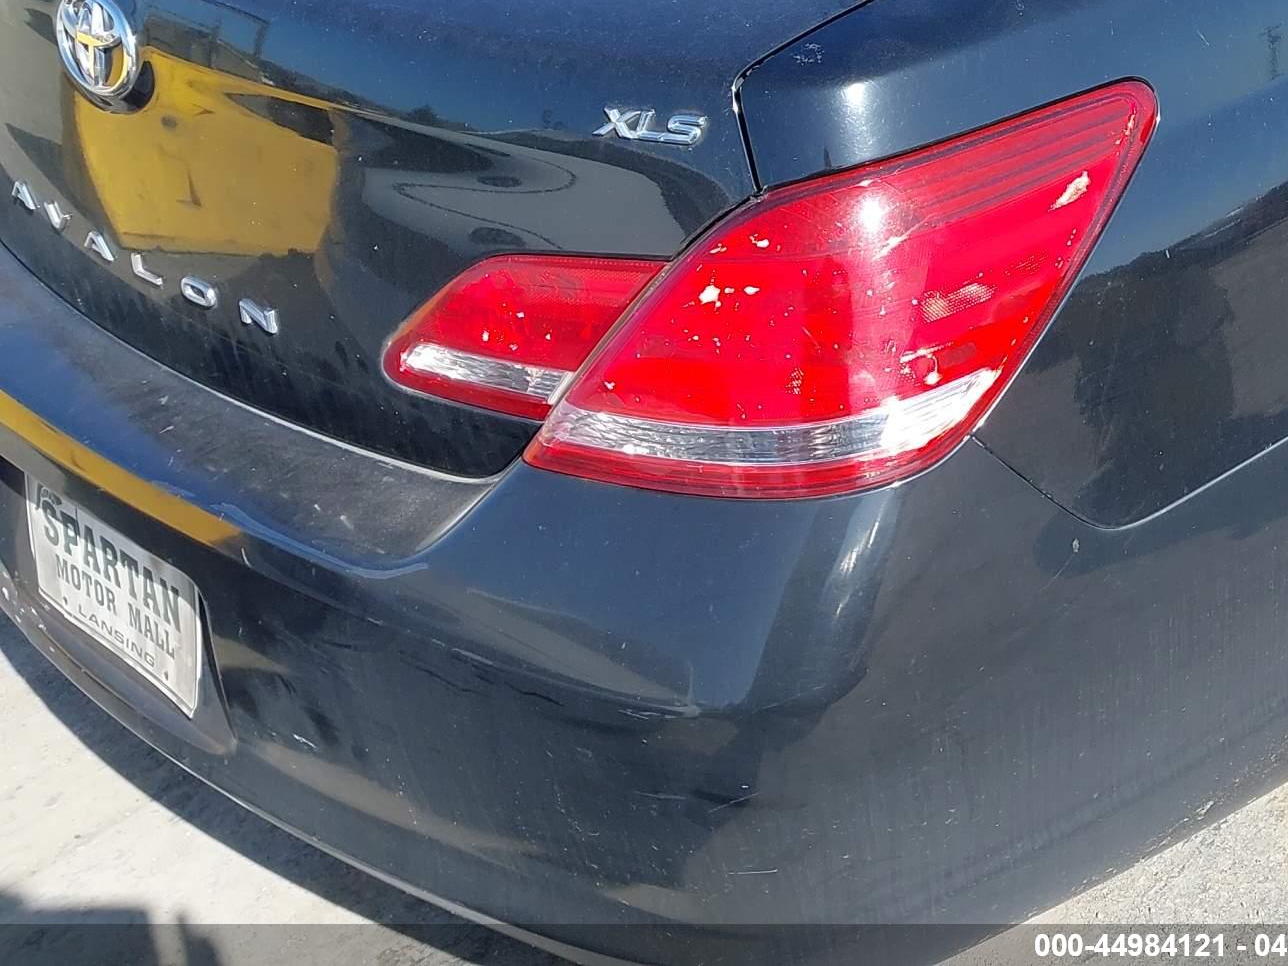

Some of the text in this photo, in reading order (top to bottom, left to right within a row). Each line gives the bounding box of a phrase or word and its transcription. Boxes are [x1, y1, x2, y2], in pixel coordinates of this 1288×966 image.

[592, 105, 708, 146] XLS
[11, 179, 279, 335] AVALON
[41, 499, 181, 634] SPARTAN
[55, 553, 176, 660] MOTOR MALL
[78, 604, 156, 668] LANSING
